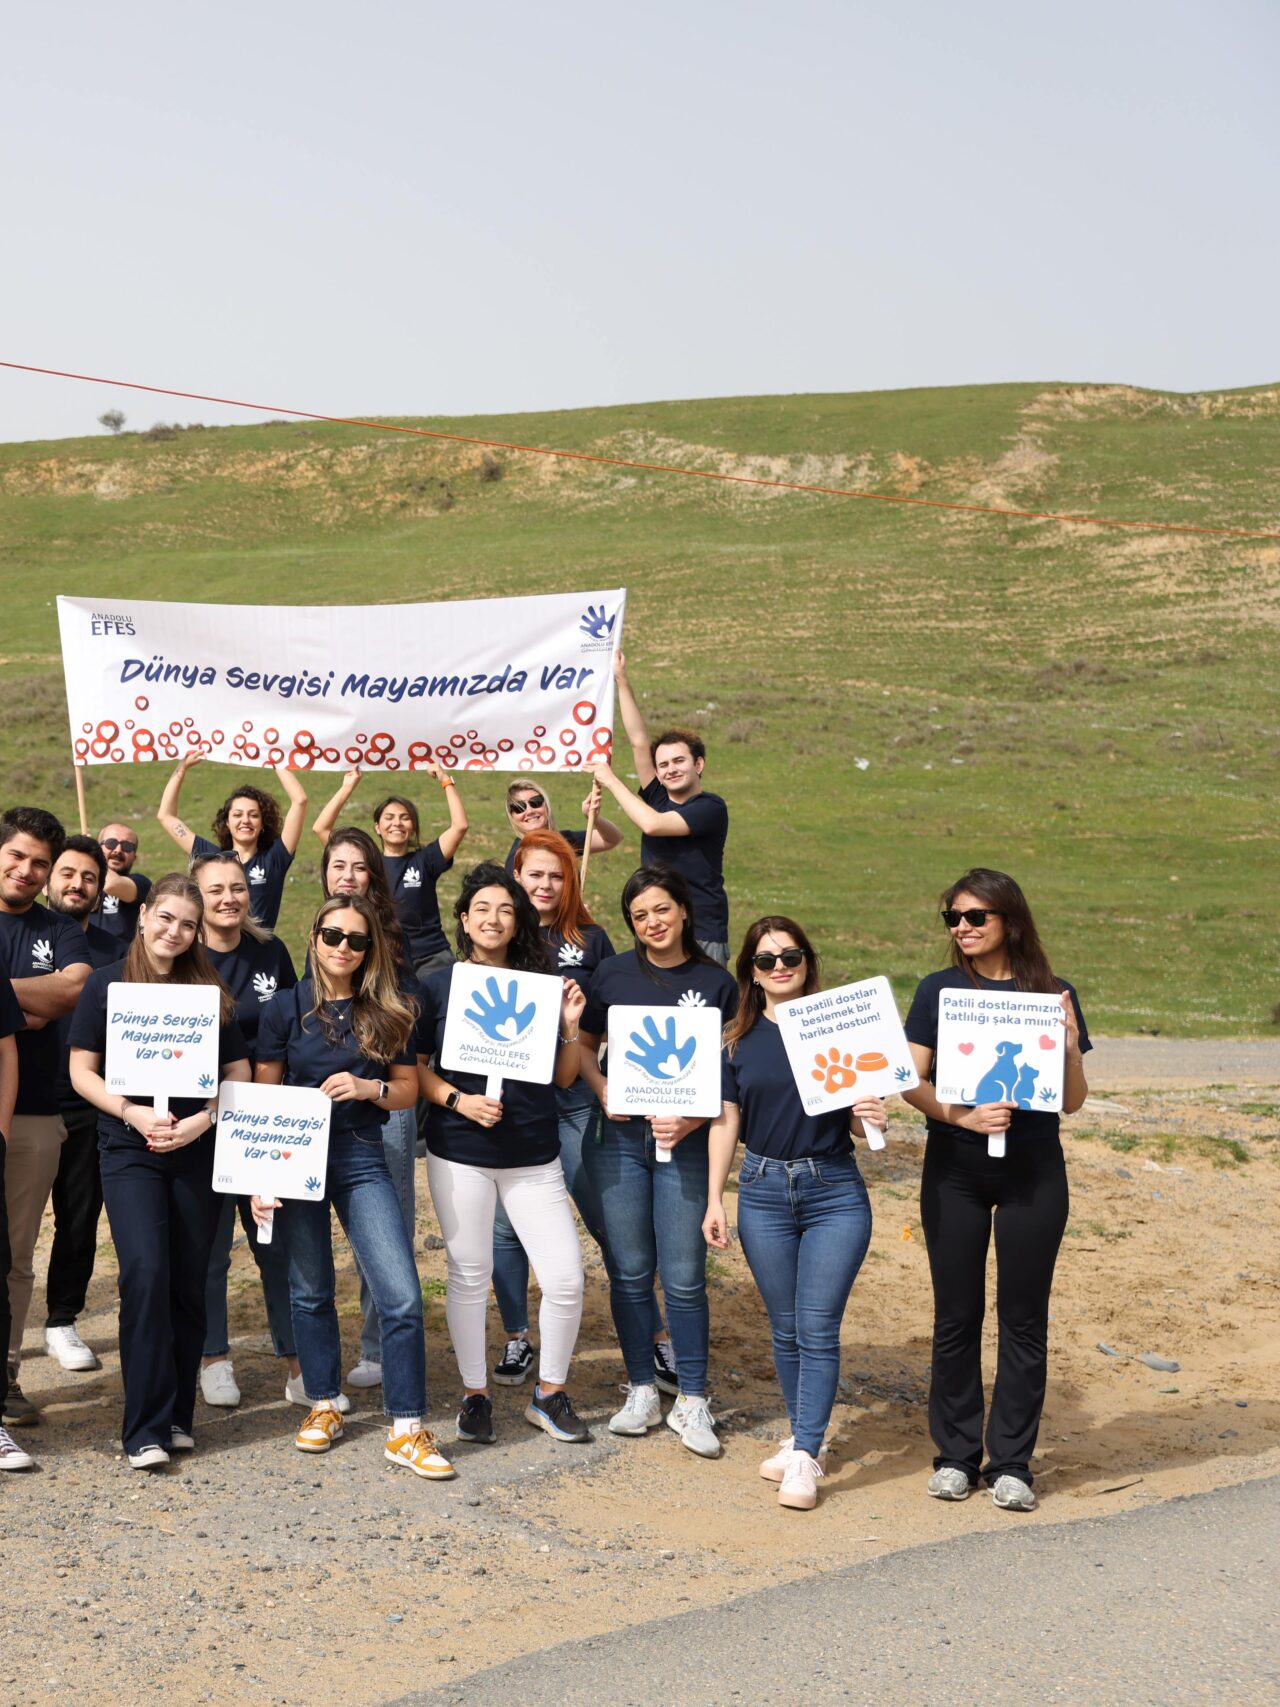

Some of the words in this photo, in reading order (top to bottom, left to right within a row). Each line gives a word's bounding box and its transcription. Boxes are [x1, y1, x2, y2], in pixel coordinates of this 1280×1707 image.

[92, 613, 132, 622] ANADOLU
[91, 621, 136, 636] EFES
[120, 655, 217, 688] Dünya
[226, 667, 335, 698] Sevgisi
[341, 664, 528, 703] Mayamızda
[540, 664, 594, 691] Var
[788, 1008, 804, 1017] Bu
[806, 998, 834, 1016] patili
[836, 988, 877, 1005] dostları
[944, 998, 974, 1008] Patili
[978, 1000, 1062, 1013] dostlarımızın
[111, 1011, 158, 1026] Dünya
[163, 1014, 216, 1028] Sevgisi
[802, 1008, 855, 1027] beslemek
[857, 1002, 872, 1013] bir
[945, 1012, 989, 1025] tatlılığı
[993, 1014, 1021, 1025] şaka
[800, 1026, 834, 1041] harika
[837, 1012, 881, 1031] dostum!
[121, 1030, 202, 1044] Mayamızda
[136, 1048, 159, 1060] Var
[459, 1044, 506, 1057] ANADOLU
[508, 1052, 530, 1060] EFES
[459, 1052, 528, 1070] Gönüllüleri
[625, 1086, 671, 1095] ANADOLU
[625, 1095, 695, 1105] Gönüllüleri
[222, 1110, 268, 1126] Dünya
[273, 1115, 326, 1131] Sevgisi
[231, 1129, 312, 1146] Mayamızda
[244, 1147, 268, 1160] Var
